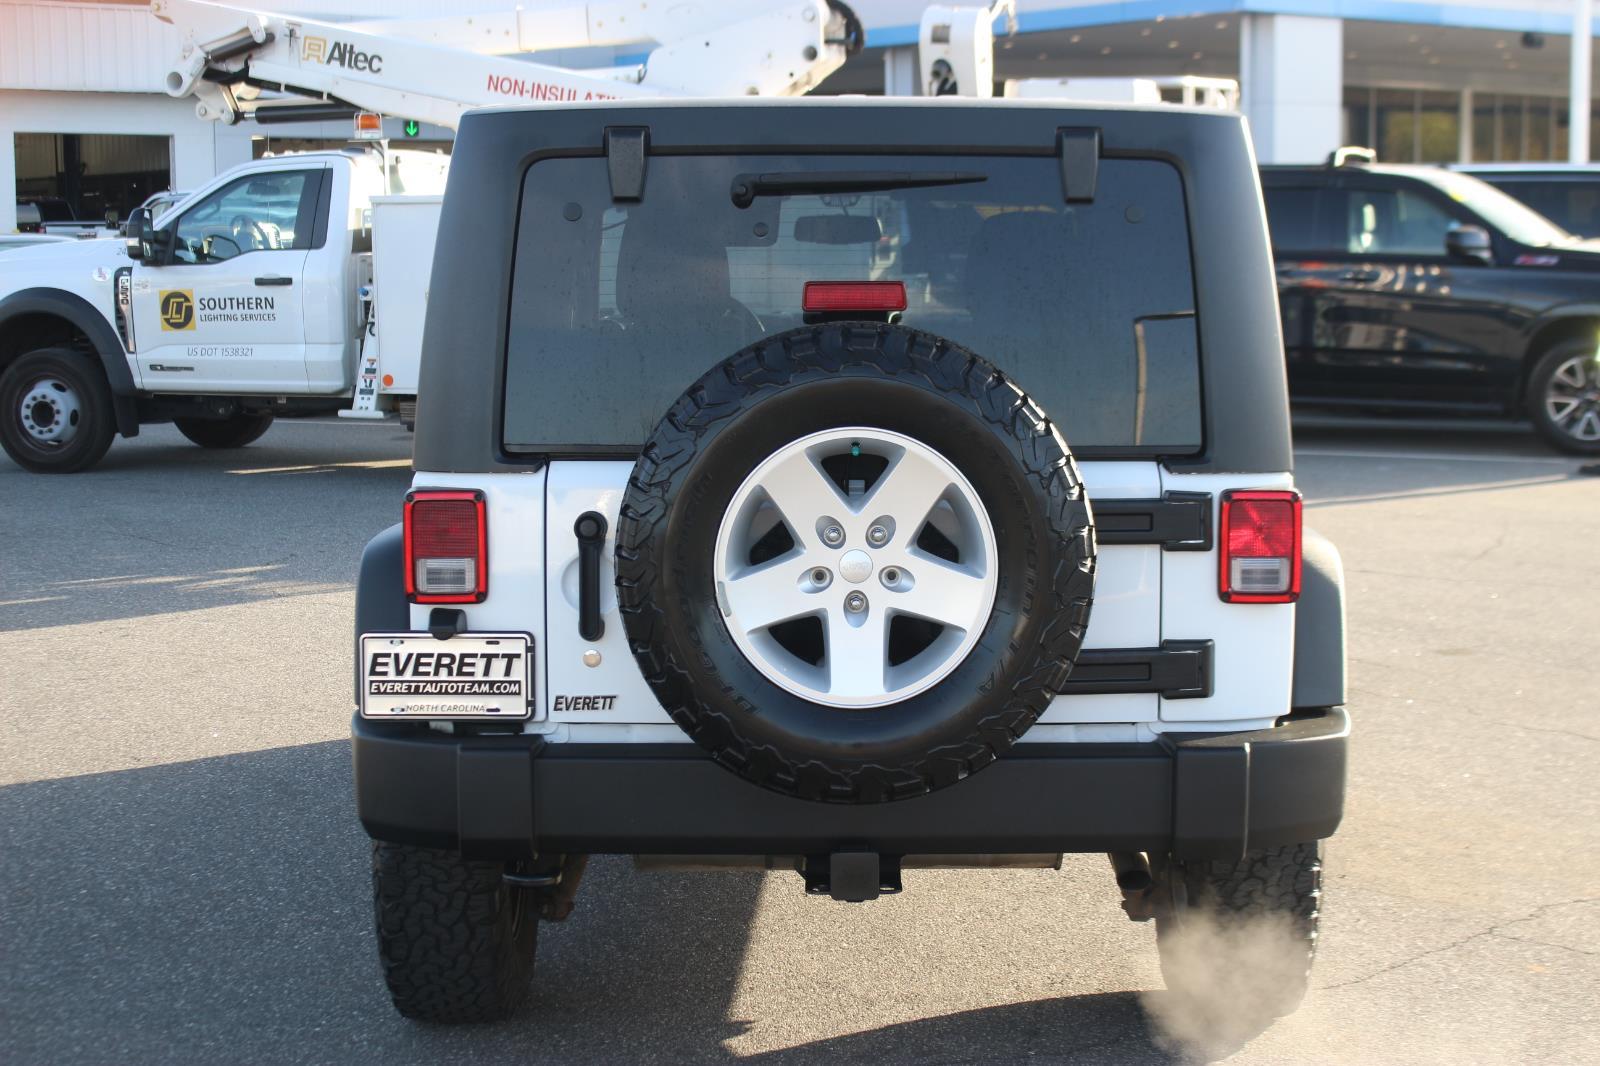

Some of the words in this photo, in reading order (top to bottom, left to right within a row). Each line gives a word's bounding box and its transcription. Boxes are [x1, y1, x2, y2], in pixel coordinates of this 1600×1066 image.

[326, 41, 383, 74] Altec
[199, 297, 275, 311] SOUTHERN
[200, 313, 238, 322] LIGHTING
[240, 313, 276, 322] SERVICES
[187, 346, 198, 357] US
[200, 346, 218, 357] DOT
[221, 346, 254, 357] 1538321
[369, 652, 521, 677] EVERETT
[370, 682, 519, 693] EVERETTAUTOTEAM.COM
[406, 704, 438, 712] NORTH
[440, 704, 485, 713] CAROLINA
[553, 695, 617, 711] EVERETT
